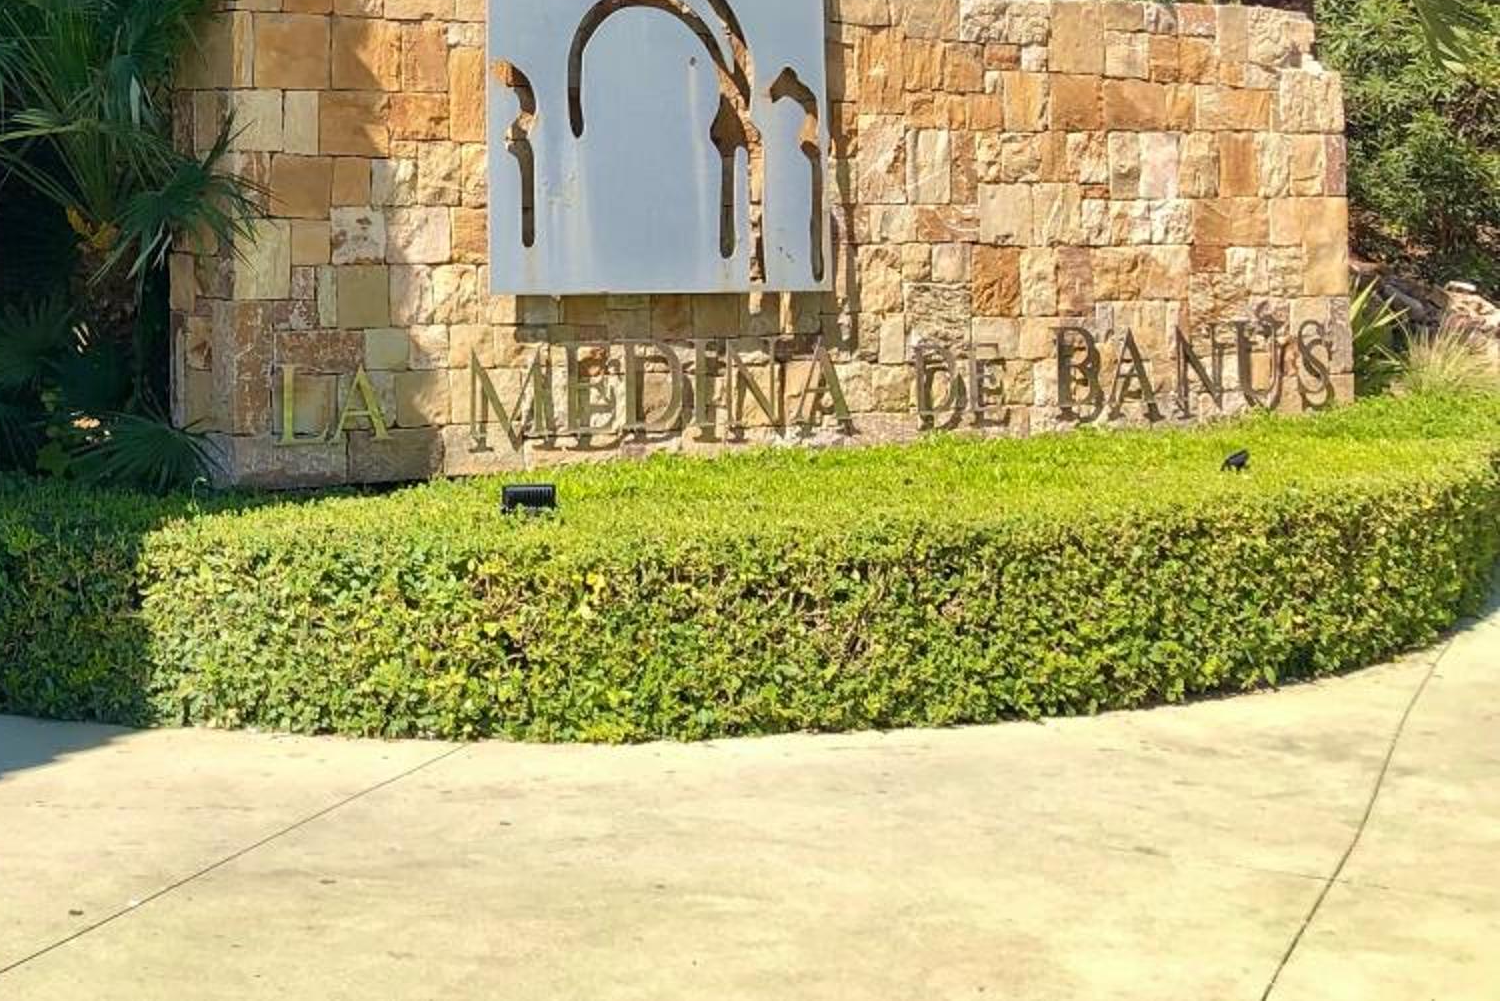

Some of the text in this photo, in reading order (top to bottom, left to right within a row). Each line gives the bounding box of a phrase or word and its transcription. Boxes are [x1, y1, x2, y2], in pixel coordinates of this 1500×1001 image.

[274, 362, 395, 446] LA
[467, 334, 852, 449] MEDINA
[913, 342, 1004, 415] DE
